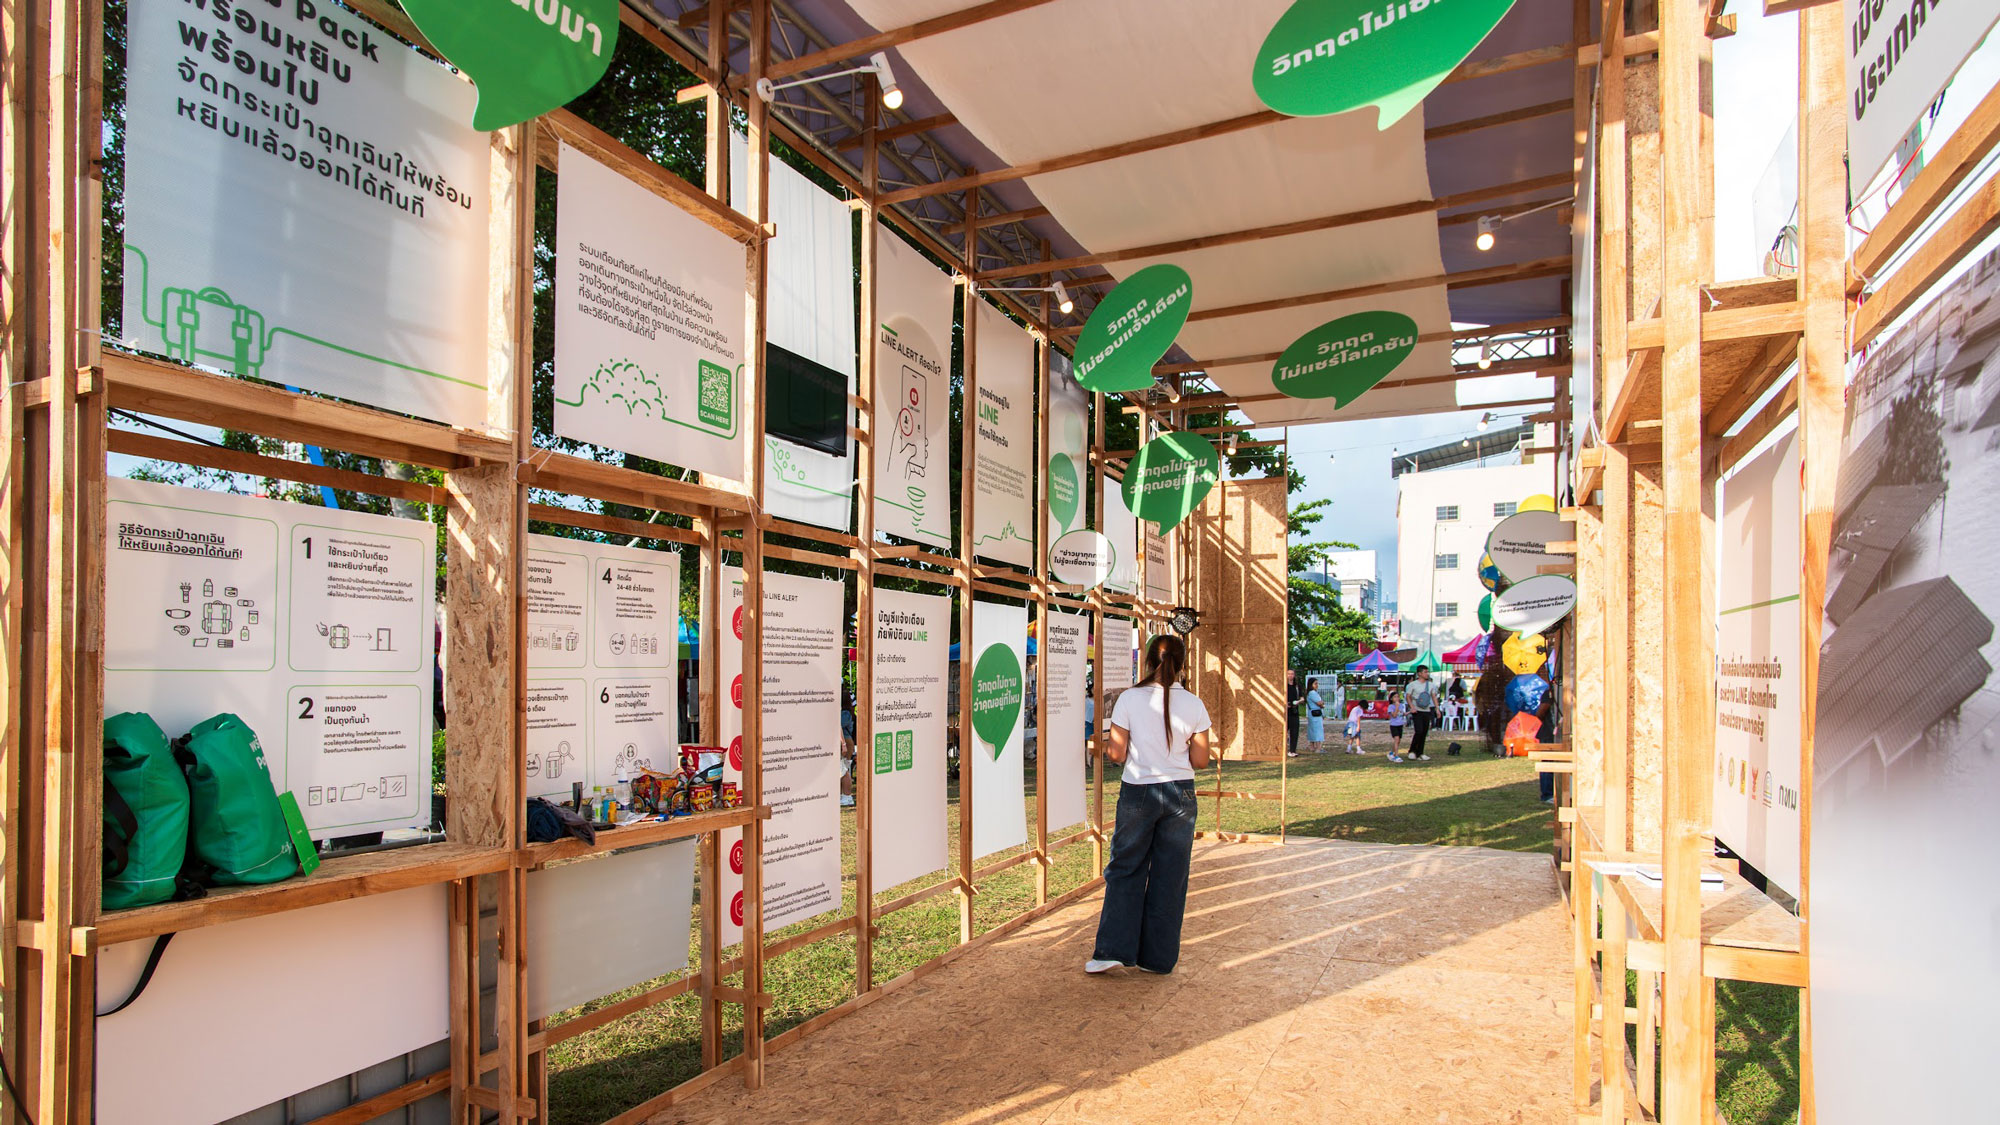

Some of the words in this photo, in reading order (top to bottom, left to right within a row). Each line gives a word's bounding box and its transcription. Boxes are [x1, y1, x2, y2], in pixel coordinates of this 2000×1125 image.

[178, 20, 319, 105] พร้อมไป
[1854, 0, 1940, 122] ประเทศ
[178, 56, 471, 210] จัดกระเป๋าฉุกเฉินให้พร้อม
[177, 97, 425, 218] หยิบแล้วออกได้ทันที
[1106, 298, 1148, 336] วิกฤต
[1078, 283, 1188, 377] ไม่ชอบแจ้งเตือน
[881, 331, 897, 352] LINE
[898, 342, 919, 363] ALERT
[1317, 332, 1375, 355] วิกฤต
[1279, 335, 1413, 381] ไม่แชร์โลเคชัน
[699, 410, 715, 421] SCAN
[715, 414, 729, 425] HERE
[978, 400, 999, 425] LINE
[1137, 458, 1208, 478] วิกฤตไม่ถาม
[1129, 470, 1213, 495] ว่าคุณอยู่ที่ไหน
[118, 523, 225, 545] วิธีจัดกระเป๋าฉุกเฉิน
[118, 536, 243, 560] ให้หยิบแล้วออกได้ทันที!
[301, 537, 313, 560] 1
[328, 545, 389, 561] ใช้กระเป๋าใบเดียว
[328, 560, 389, 575] และหยิบง่ายที่สุด
[602, 567, 612, 584] 4
[769, 592, 781, 601] LINE
[781, 594, 798, 602] ALERT
[878, 610, 925, 626] บัญชีแจ้งเตือน
[877, 627, 912, 641] ภัยพิบัติบน
[913, 630, 928, 642] LINE
[600, 687, 609, 703] 6
[884, 686, 894, 694] LINE
[894, 686, 909, 694] Official
[977, 674, 1017, 694] วิกฤตไม่ถาม
[973, 689, 1020, 714] ว่าคุณอยู่ที่ไหน
[1735, 686, 1748, 705] LINE
[298, 697, 314, 719] 2
[324, 704, 357, 713] แยกของ
[532, 704, 546, 712] เดือน
[324, 714, 370, 727] เป็นถุงกันน้ำ
